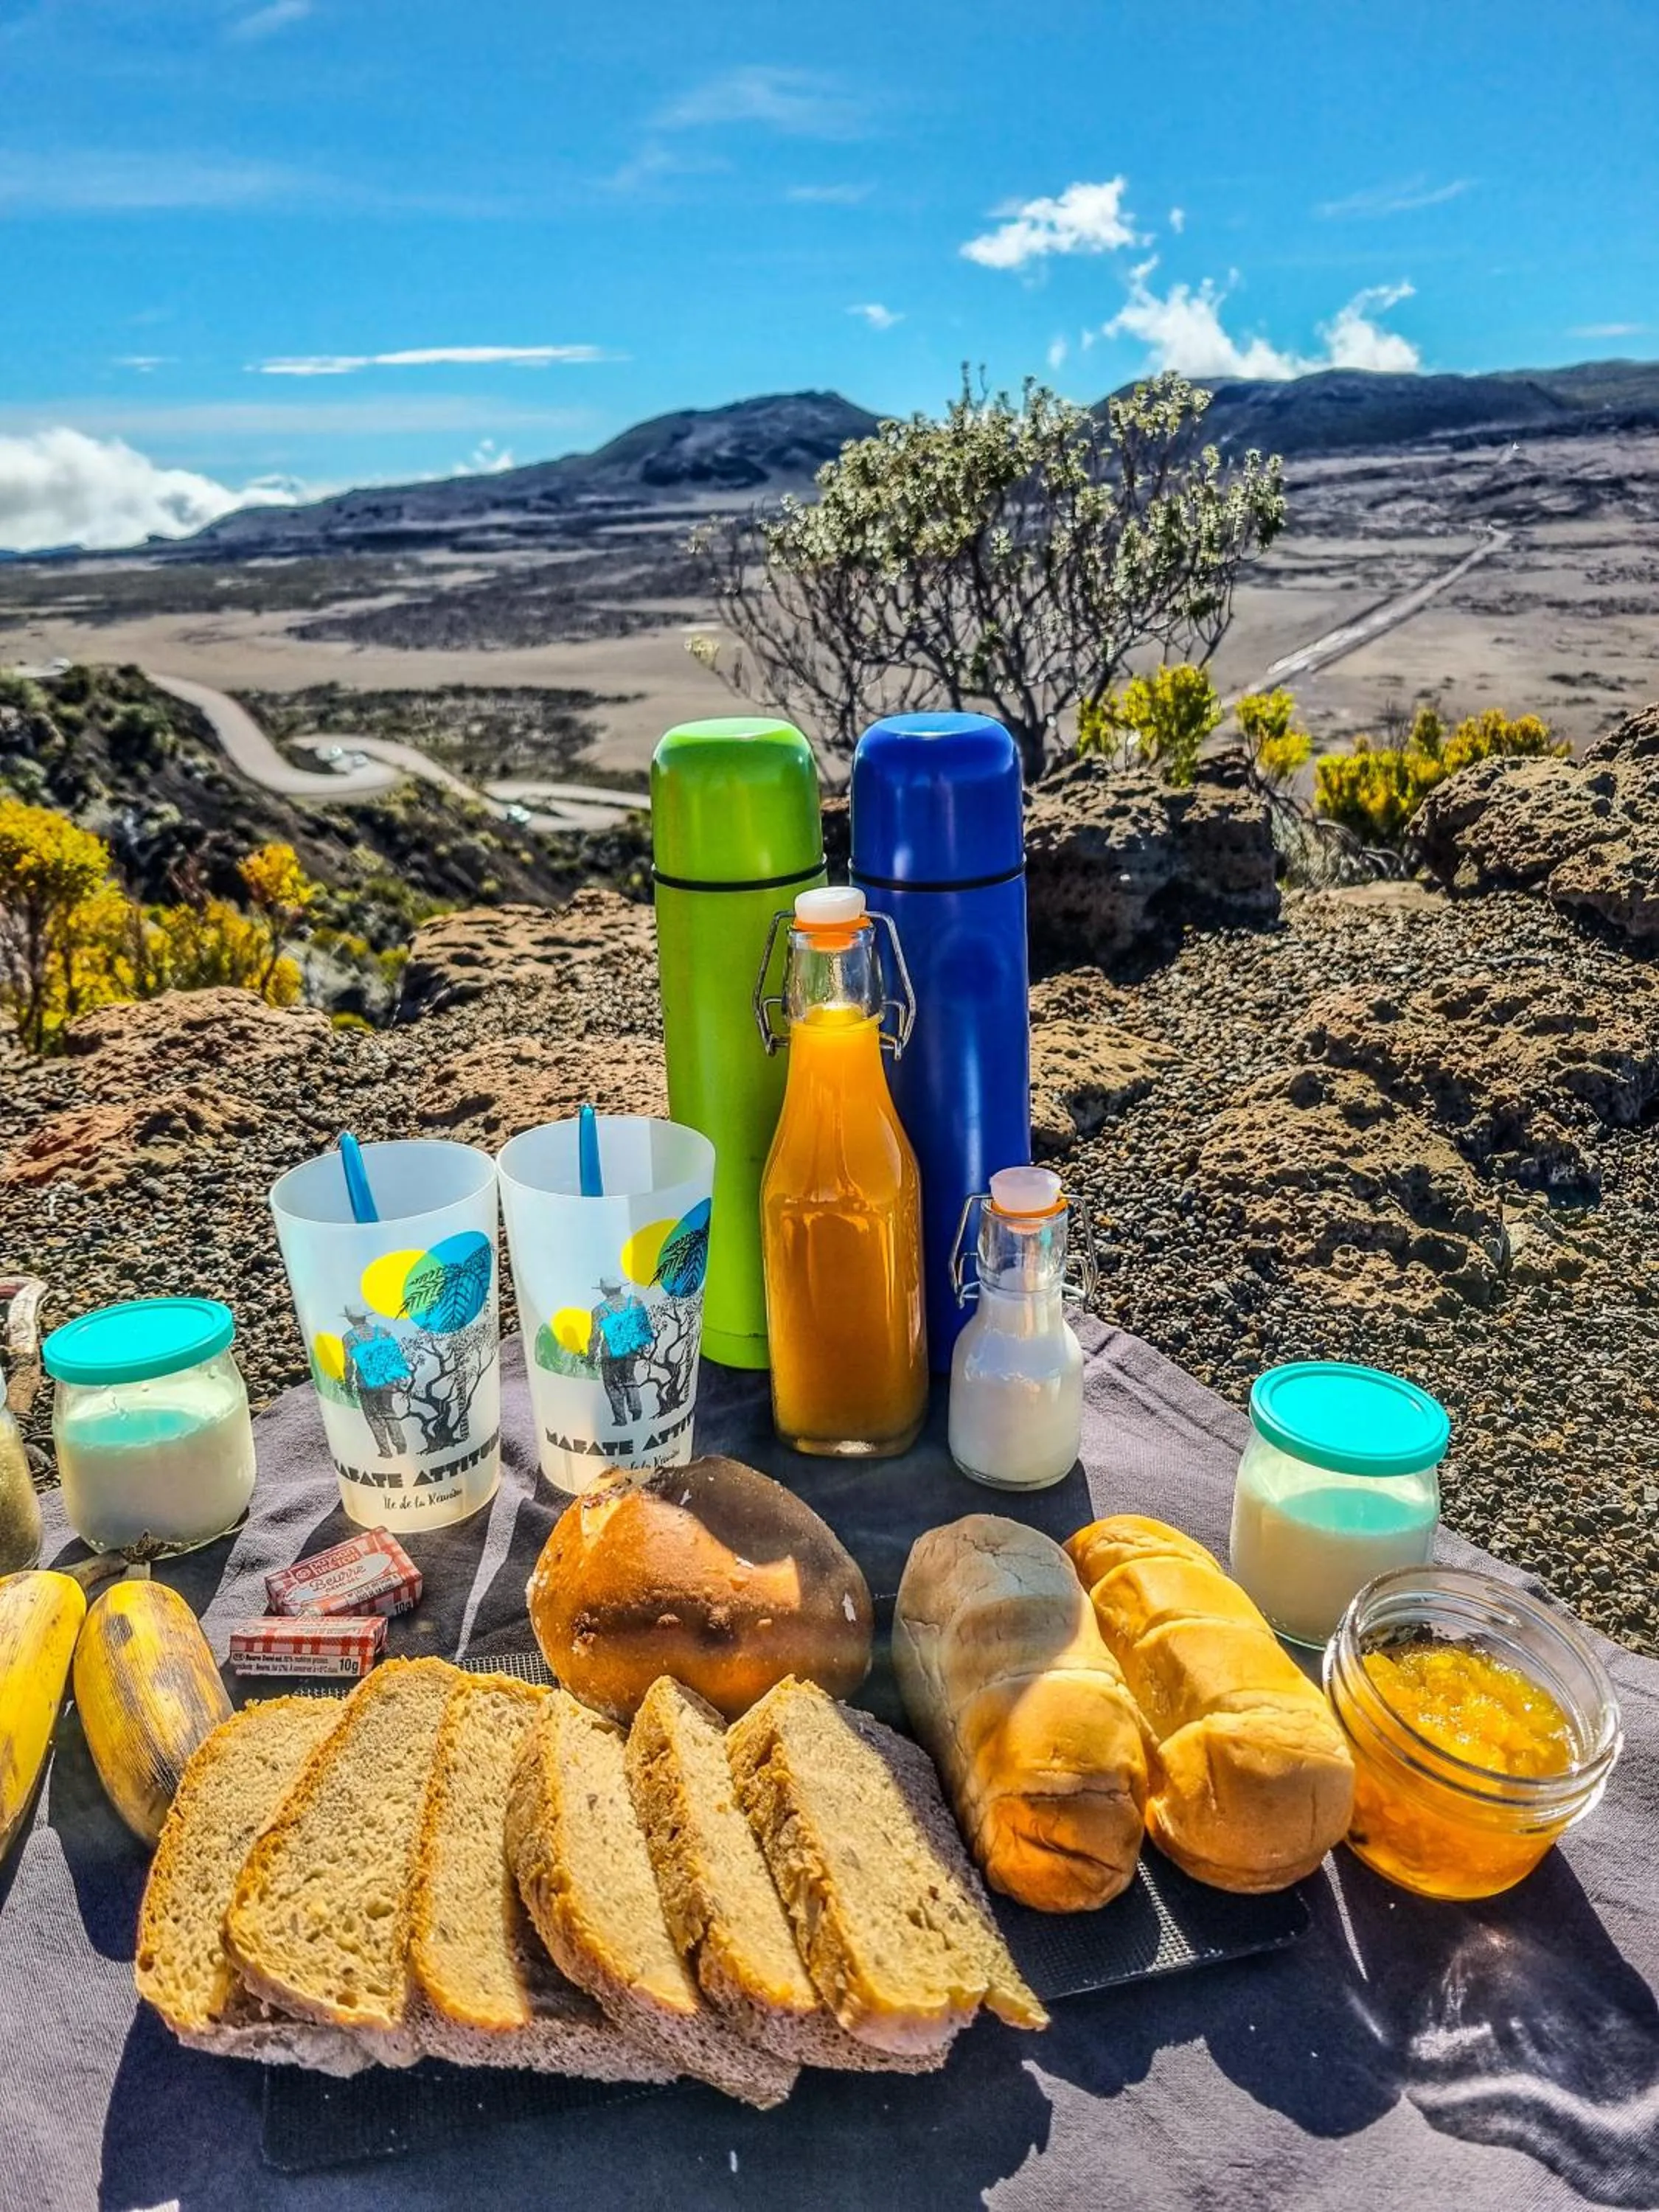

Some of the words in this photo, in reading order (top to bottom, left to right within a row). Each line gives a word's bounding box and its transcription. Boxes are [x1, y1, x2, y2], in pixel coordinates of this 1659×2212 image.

[545, 1427, 633, 1455] MAFATE
[309, 1565, 366, 1591] Beurre
[338, 1658, 360, 1674] 10g
